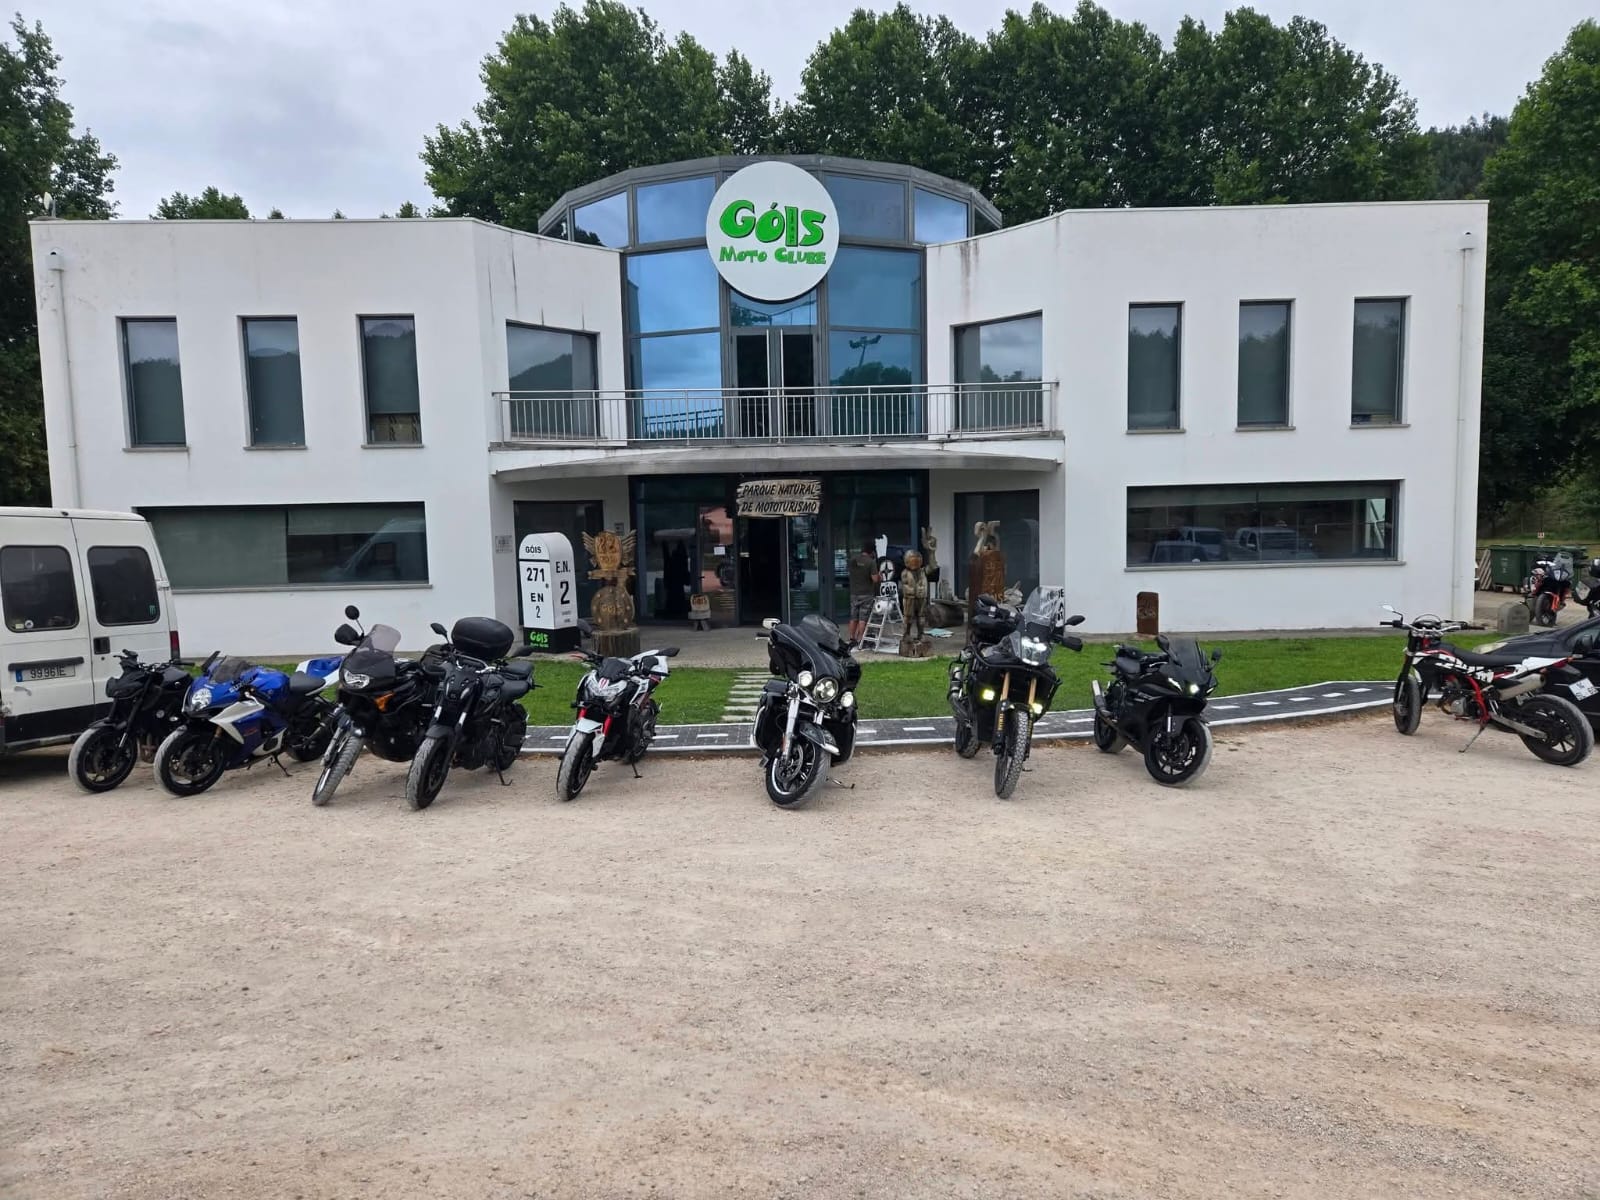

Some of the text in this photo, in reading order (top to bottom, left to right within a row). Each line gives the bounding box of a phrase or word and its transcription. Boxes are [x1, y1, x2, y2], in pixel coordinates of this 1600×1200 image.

[719, 200, 826, 247] GÓIS
[743, 483, 816, 496] PARQUE NATURAL
[742, 501, 817, 513] DE MOTOTURISMO
[526, 567, 545, 582] 271
[530, 592, 544, 602] EN
[560, 580, 570, 605] 2
[535, 605, 541, 618] 2
